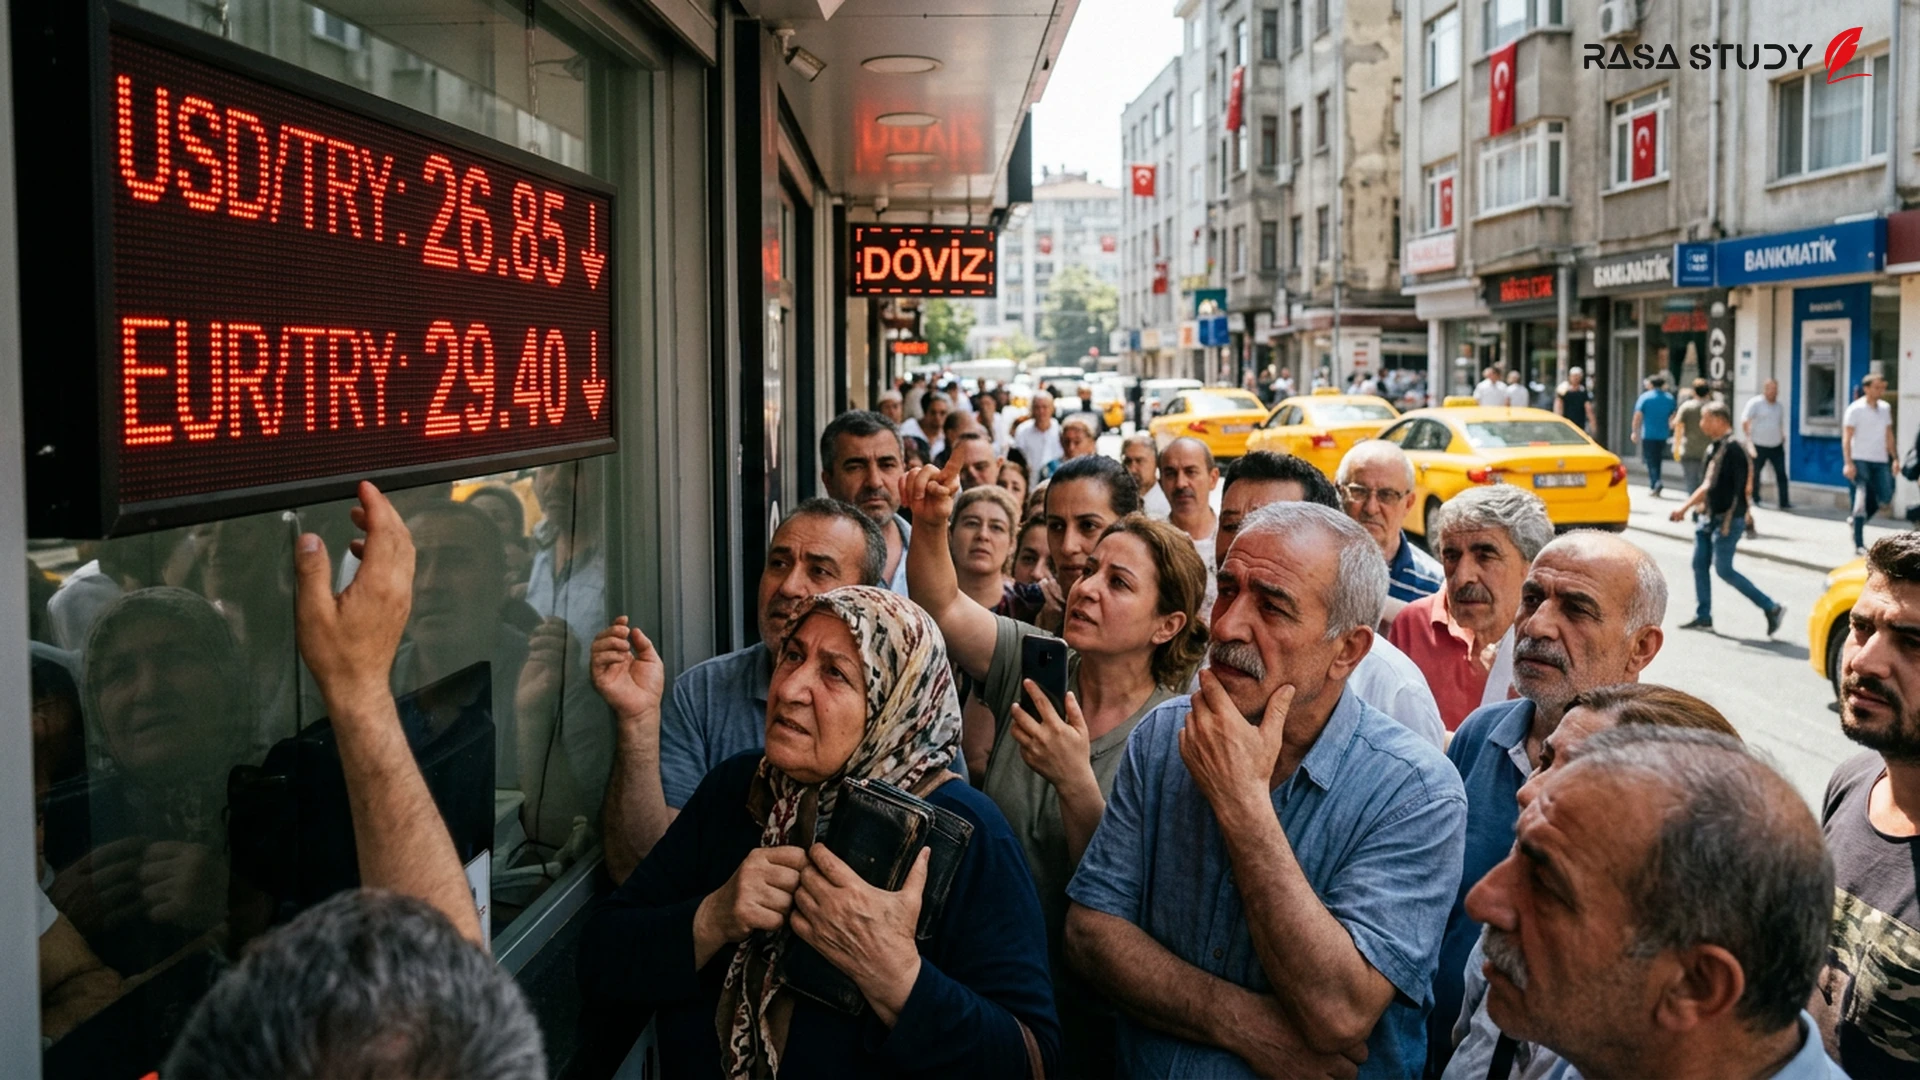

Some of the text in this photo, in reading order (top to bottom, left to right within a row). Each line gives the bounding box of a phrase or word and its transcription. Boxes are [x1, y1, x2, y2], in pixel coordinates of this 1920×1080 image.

[118, 74, 567, 287] USD/TRY: 26.85
[863, 239, 987, 282] DÖVİZ
[1744, 235, 1836, 272] BANKMATİK
[122, 317, 567, 445] EUR/TRY: 29.40
